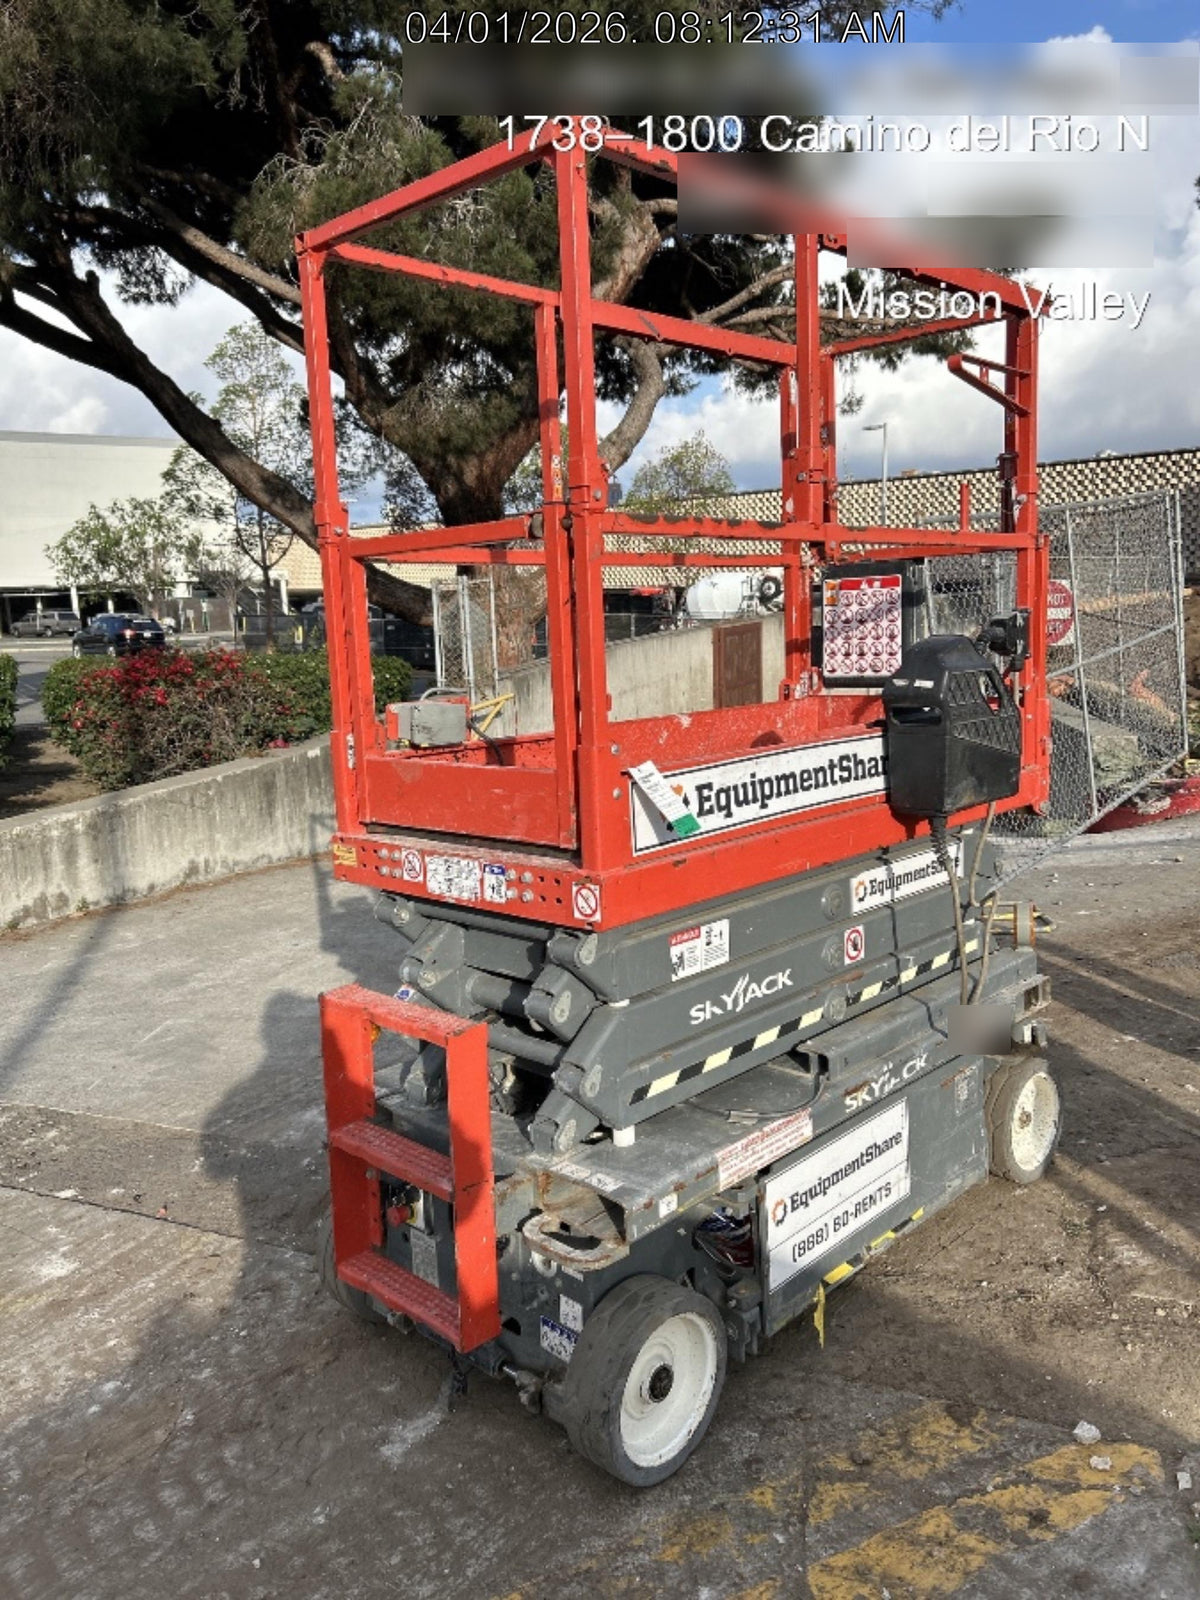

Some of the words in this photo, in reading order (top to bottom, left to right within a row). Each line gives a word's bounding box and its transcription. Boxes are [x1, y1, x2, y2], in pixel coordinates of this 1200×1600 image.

[695, 753, 889, 818] EquipmentShar
[689, 968, 793, 1025] SKYJACK
[789, 1131, 903, 1213] EquipmentShare
[792, 1222, 830, 1263] (888)
[833, 1181, 892, 1233] 60-RENTS
